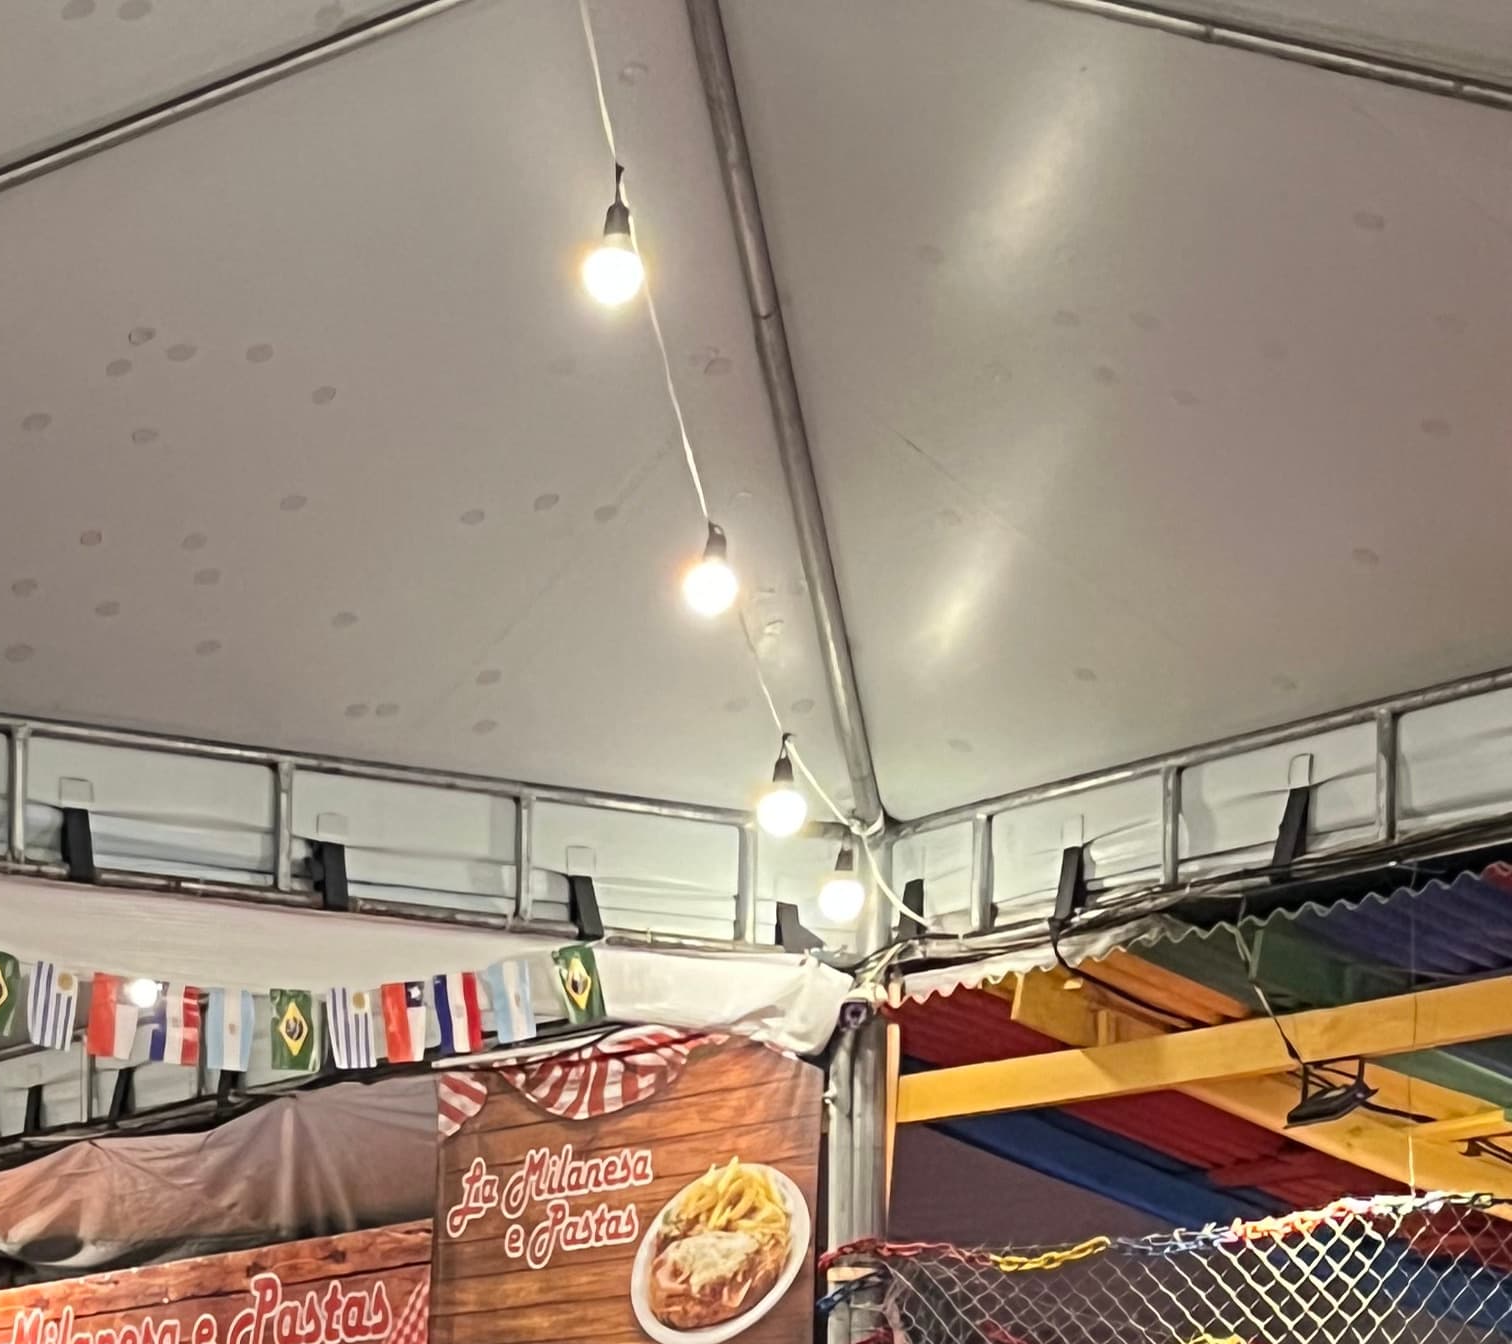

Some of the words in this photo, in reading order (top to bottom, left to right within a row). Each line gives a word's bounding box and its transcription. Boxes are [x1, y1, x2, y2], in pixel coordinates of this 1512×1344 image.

[447, 1157, 499, 1238] La
[501, 1144, 653, 1219] Milanesa
[505, 1224, 525, 1258] e
[527, 1200, 639, 1269] Pastas
